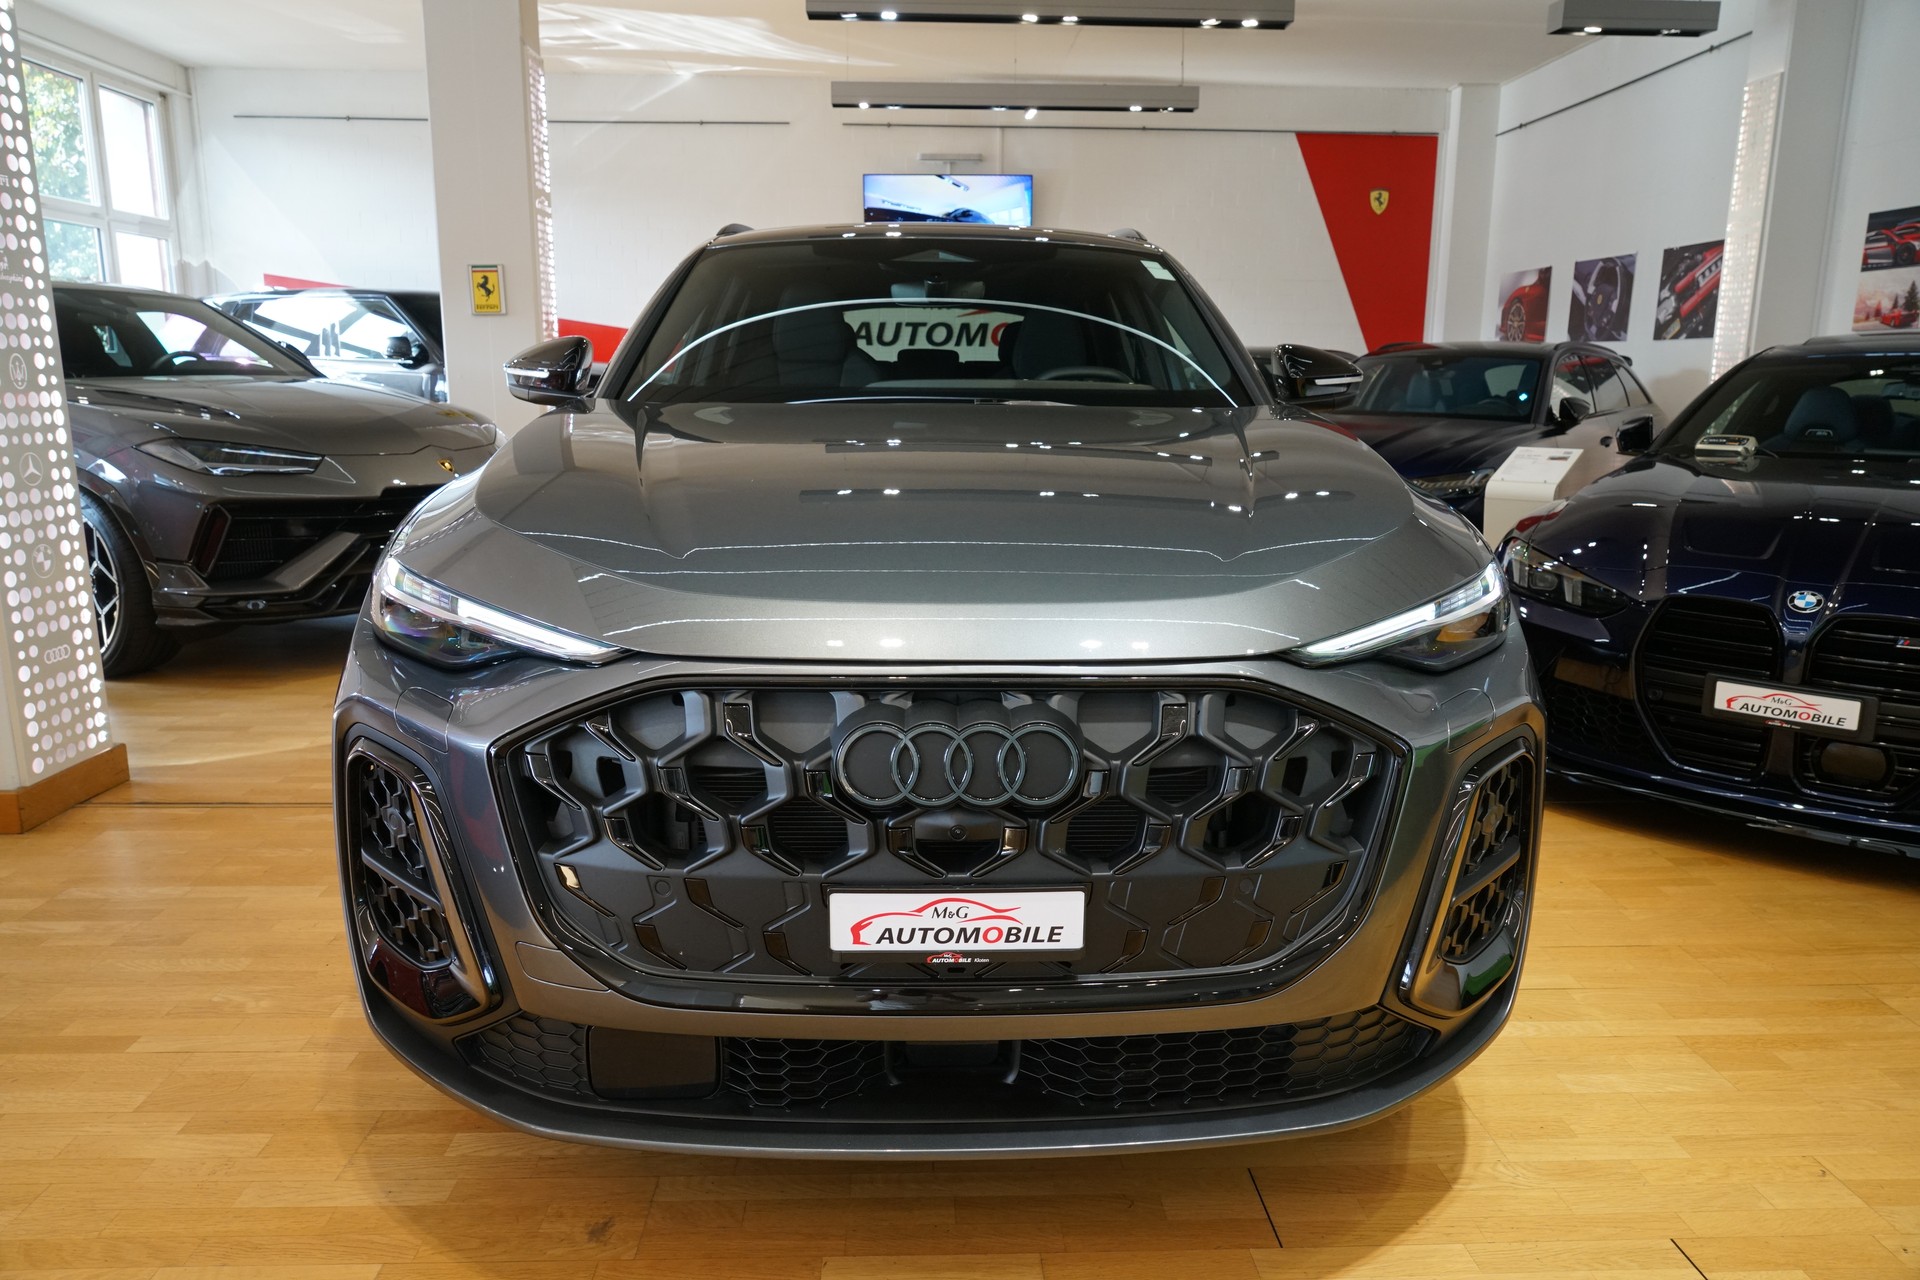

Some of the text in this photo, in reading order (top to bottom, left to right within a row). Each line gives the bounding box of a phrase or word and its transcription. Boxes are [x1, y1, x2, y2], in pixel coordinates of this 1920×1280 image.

[1771, 697, 1792, 706] M&G
[1739, 703, 1847, 727] AUTOMOBILE
[931, 906, 970, 919] M&G
[876, 925, 1064, 944] AUTOMOBILE
